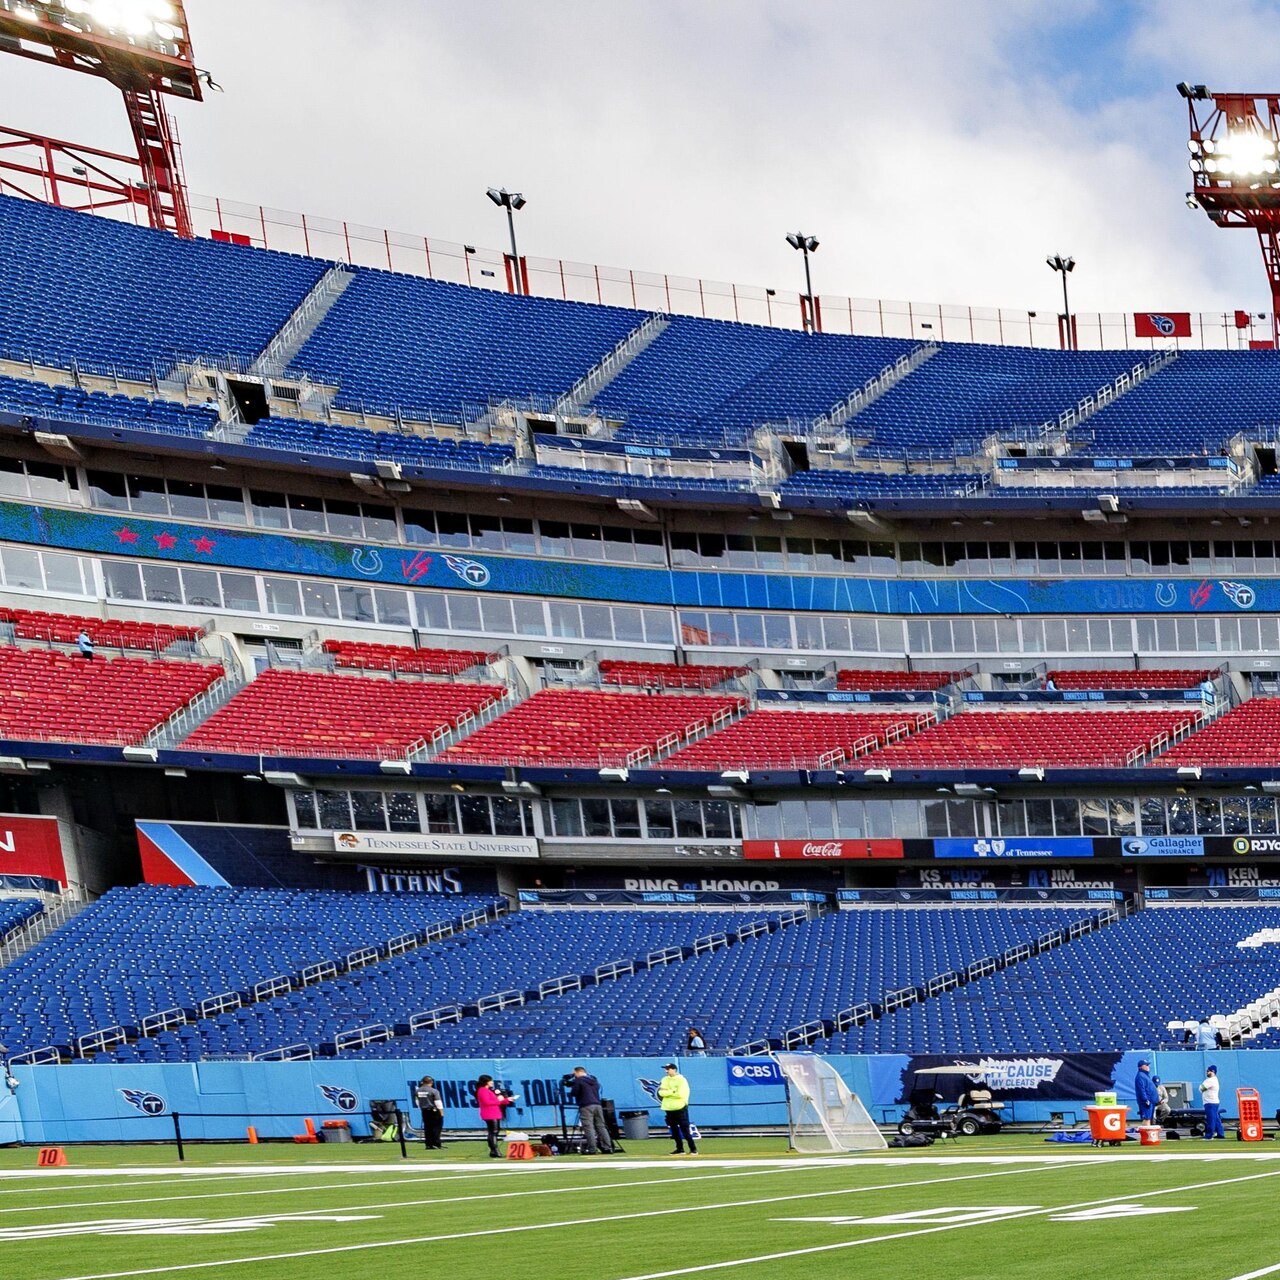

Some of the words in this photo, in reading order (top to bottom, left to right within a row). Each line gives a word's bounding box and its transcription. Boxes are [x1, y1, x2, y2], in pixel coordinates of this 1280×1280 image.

[364, 836, 431, 850] TENNESSEE
[432, 838, 467, 852] STATE
[469, 840, 534, 855] UNIVERSITY
[1149, 838, 1202, 849] Gallagher
[1006, 848, 1015, 856] of
[1016, 848, 1052, 856] Tennessee
[357, 865, 462, 894] TITANS
[1051, 869, 1075, 881] JIM
[1228, 868, 1258, 879] KEN
[625, 879, 679, 891] RING
[745, 1065, 771, 1077] CBS
[1008, 1065, 1052, 1077] CAUSE
[1006, 1079, 1035, 1087] CLEATS
[42, 1149, 58, 1164] 10
[509, 1143, 525, 1158] 20
